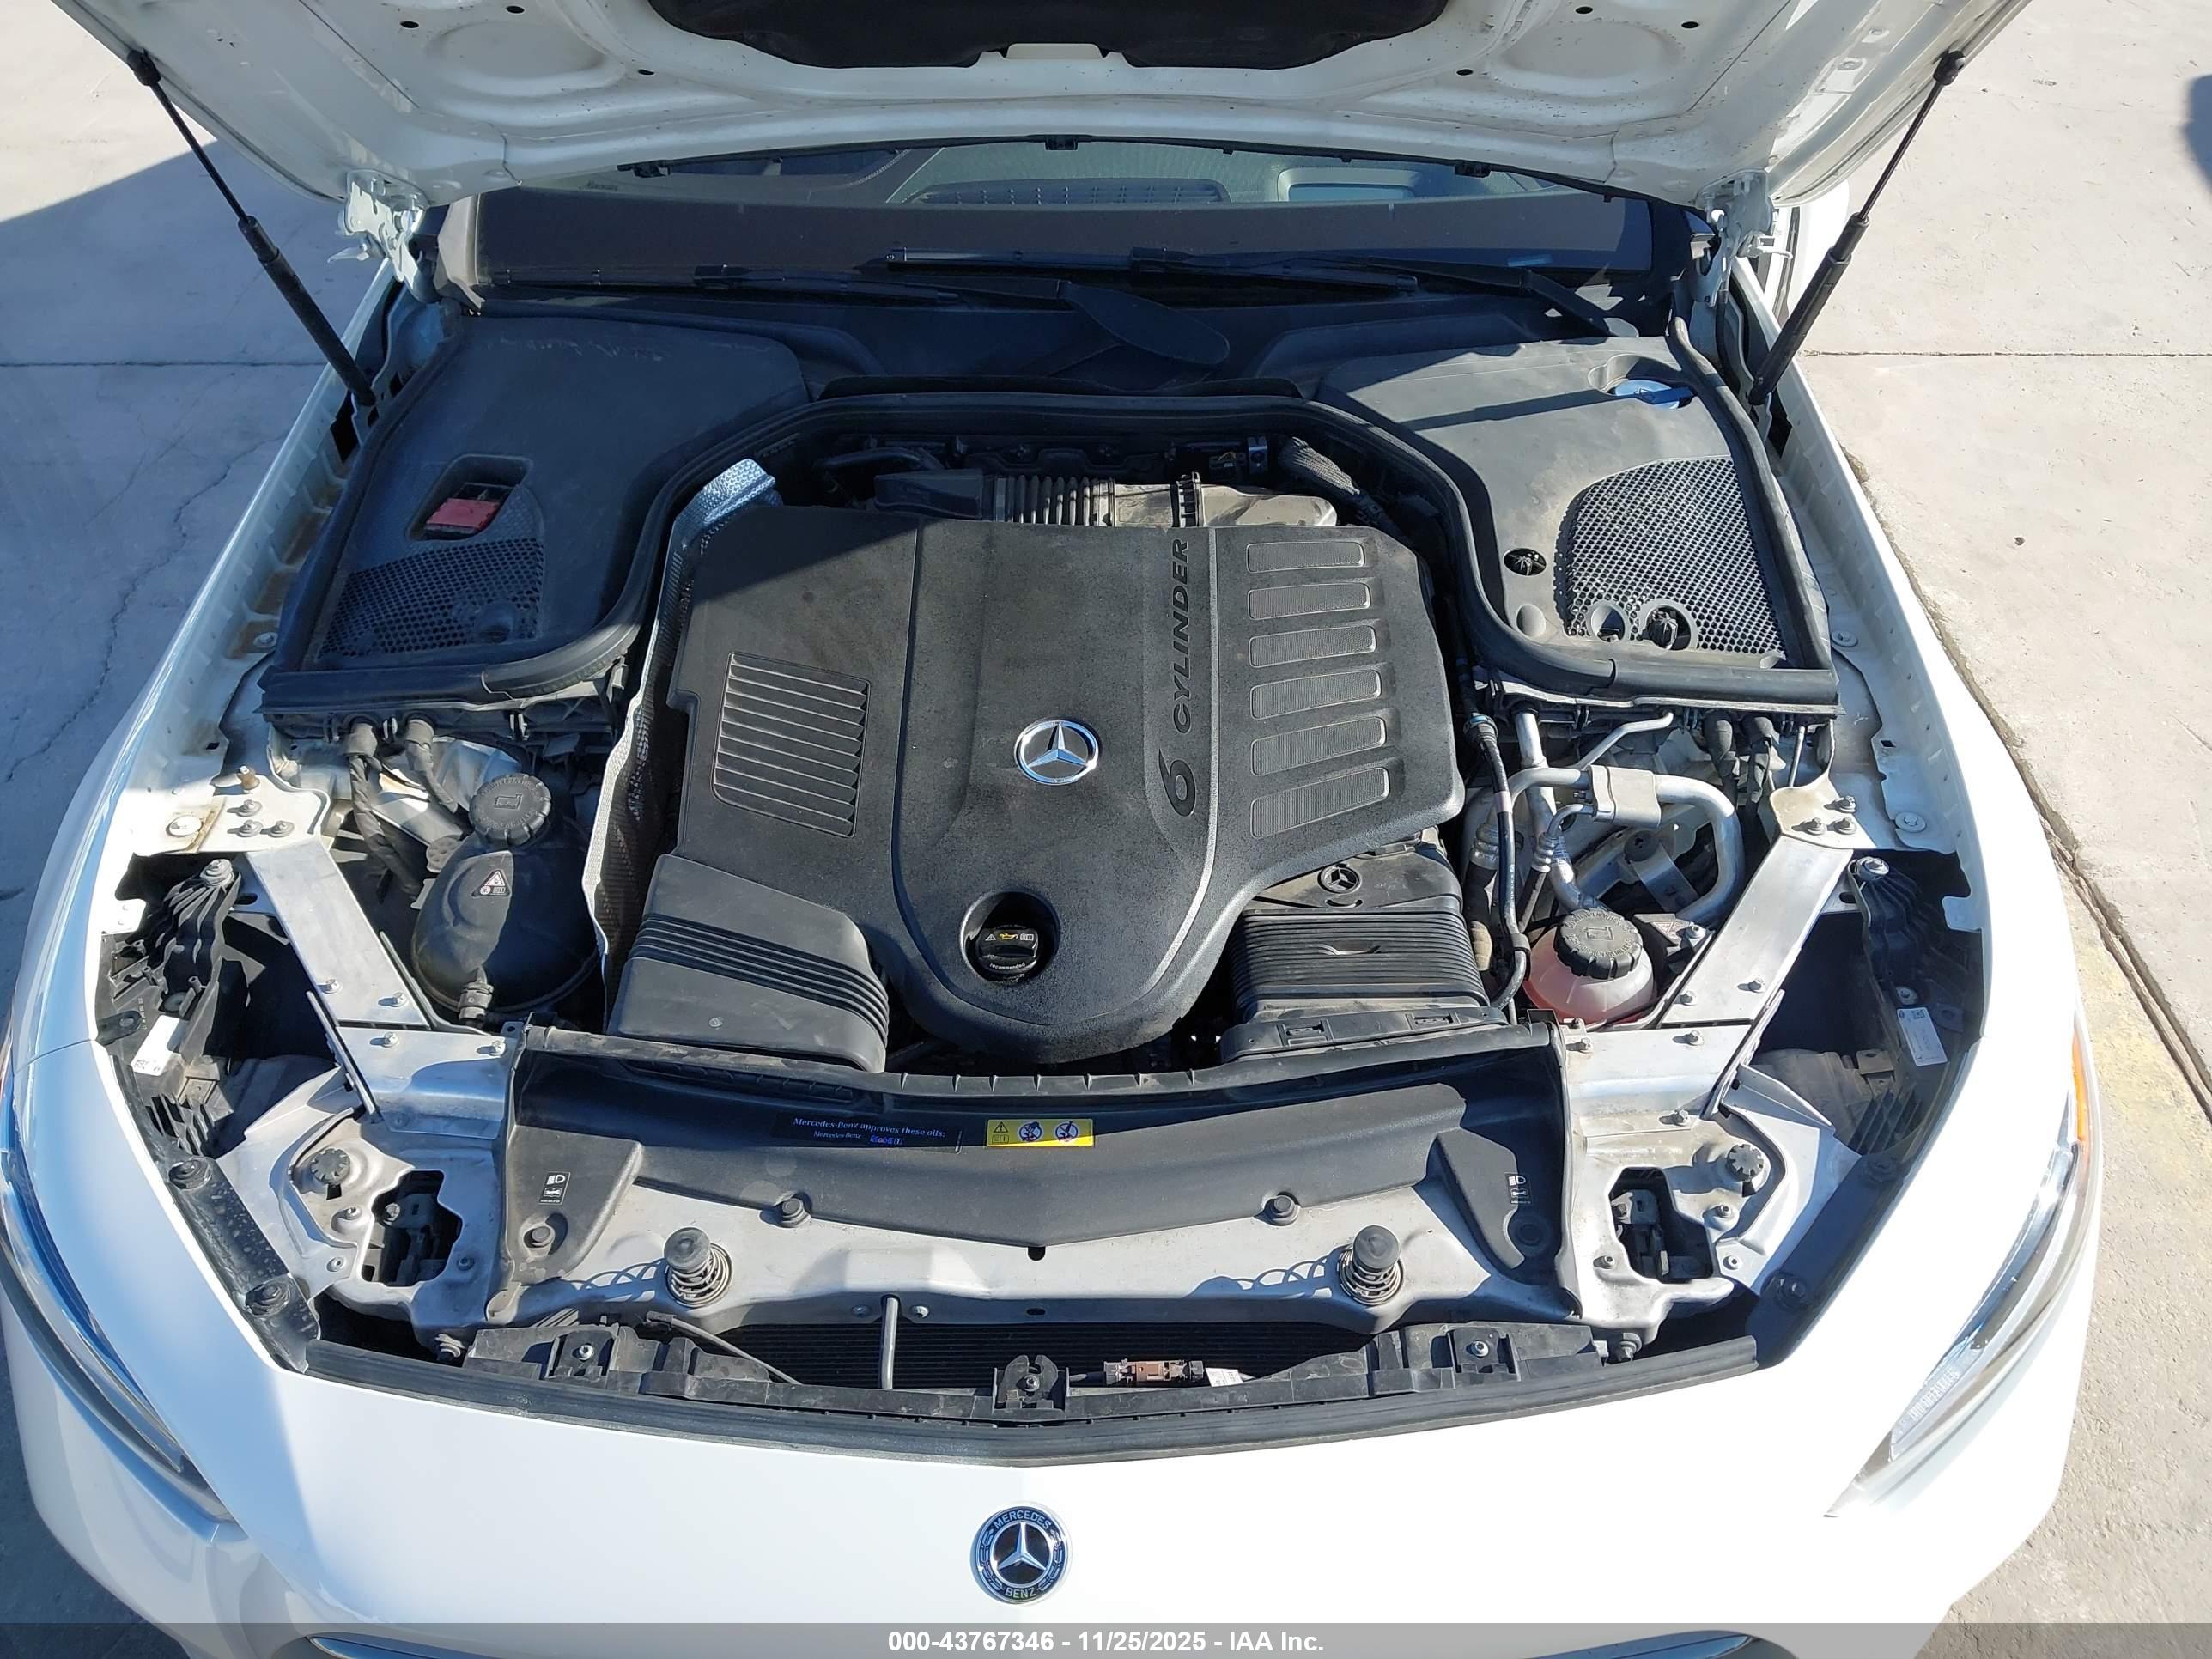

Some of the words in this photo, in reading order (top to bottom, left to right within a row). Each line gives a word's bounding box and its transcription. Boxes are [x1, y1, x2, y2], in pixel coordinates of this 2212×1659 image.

[1172, 538, 1192, 734] CYLINDER
[1158, 748, 1196, 817] 6
[989, 962, 1026, 970] recommended
[793, 1117, 860, 1129] Mercedes-Benz
[860, 1123, 899, 1134] approves
[902, 1127, 926, 1136] these
[994, 1510, 1052, 1529] MERCEDES
[1005, 1587, 1037, 1599] BENZ
